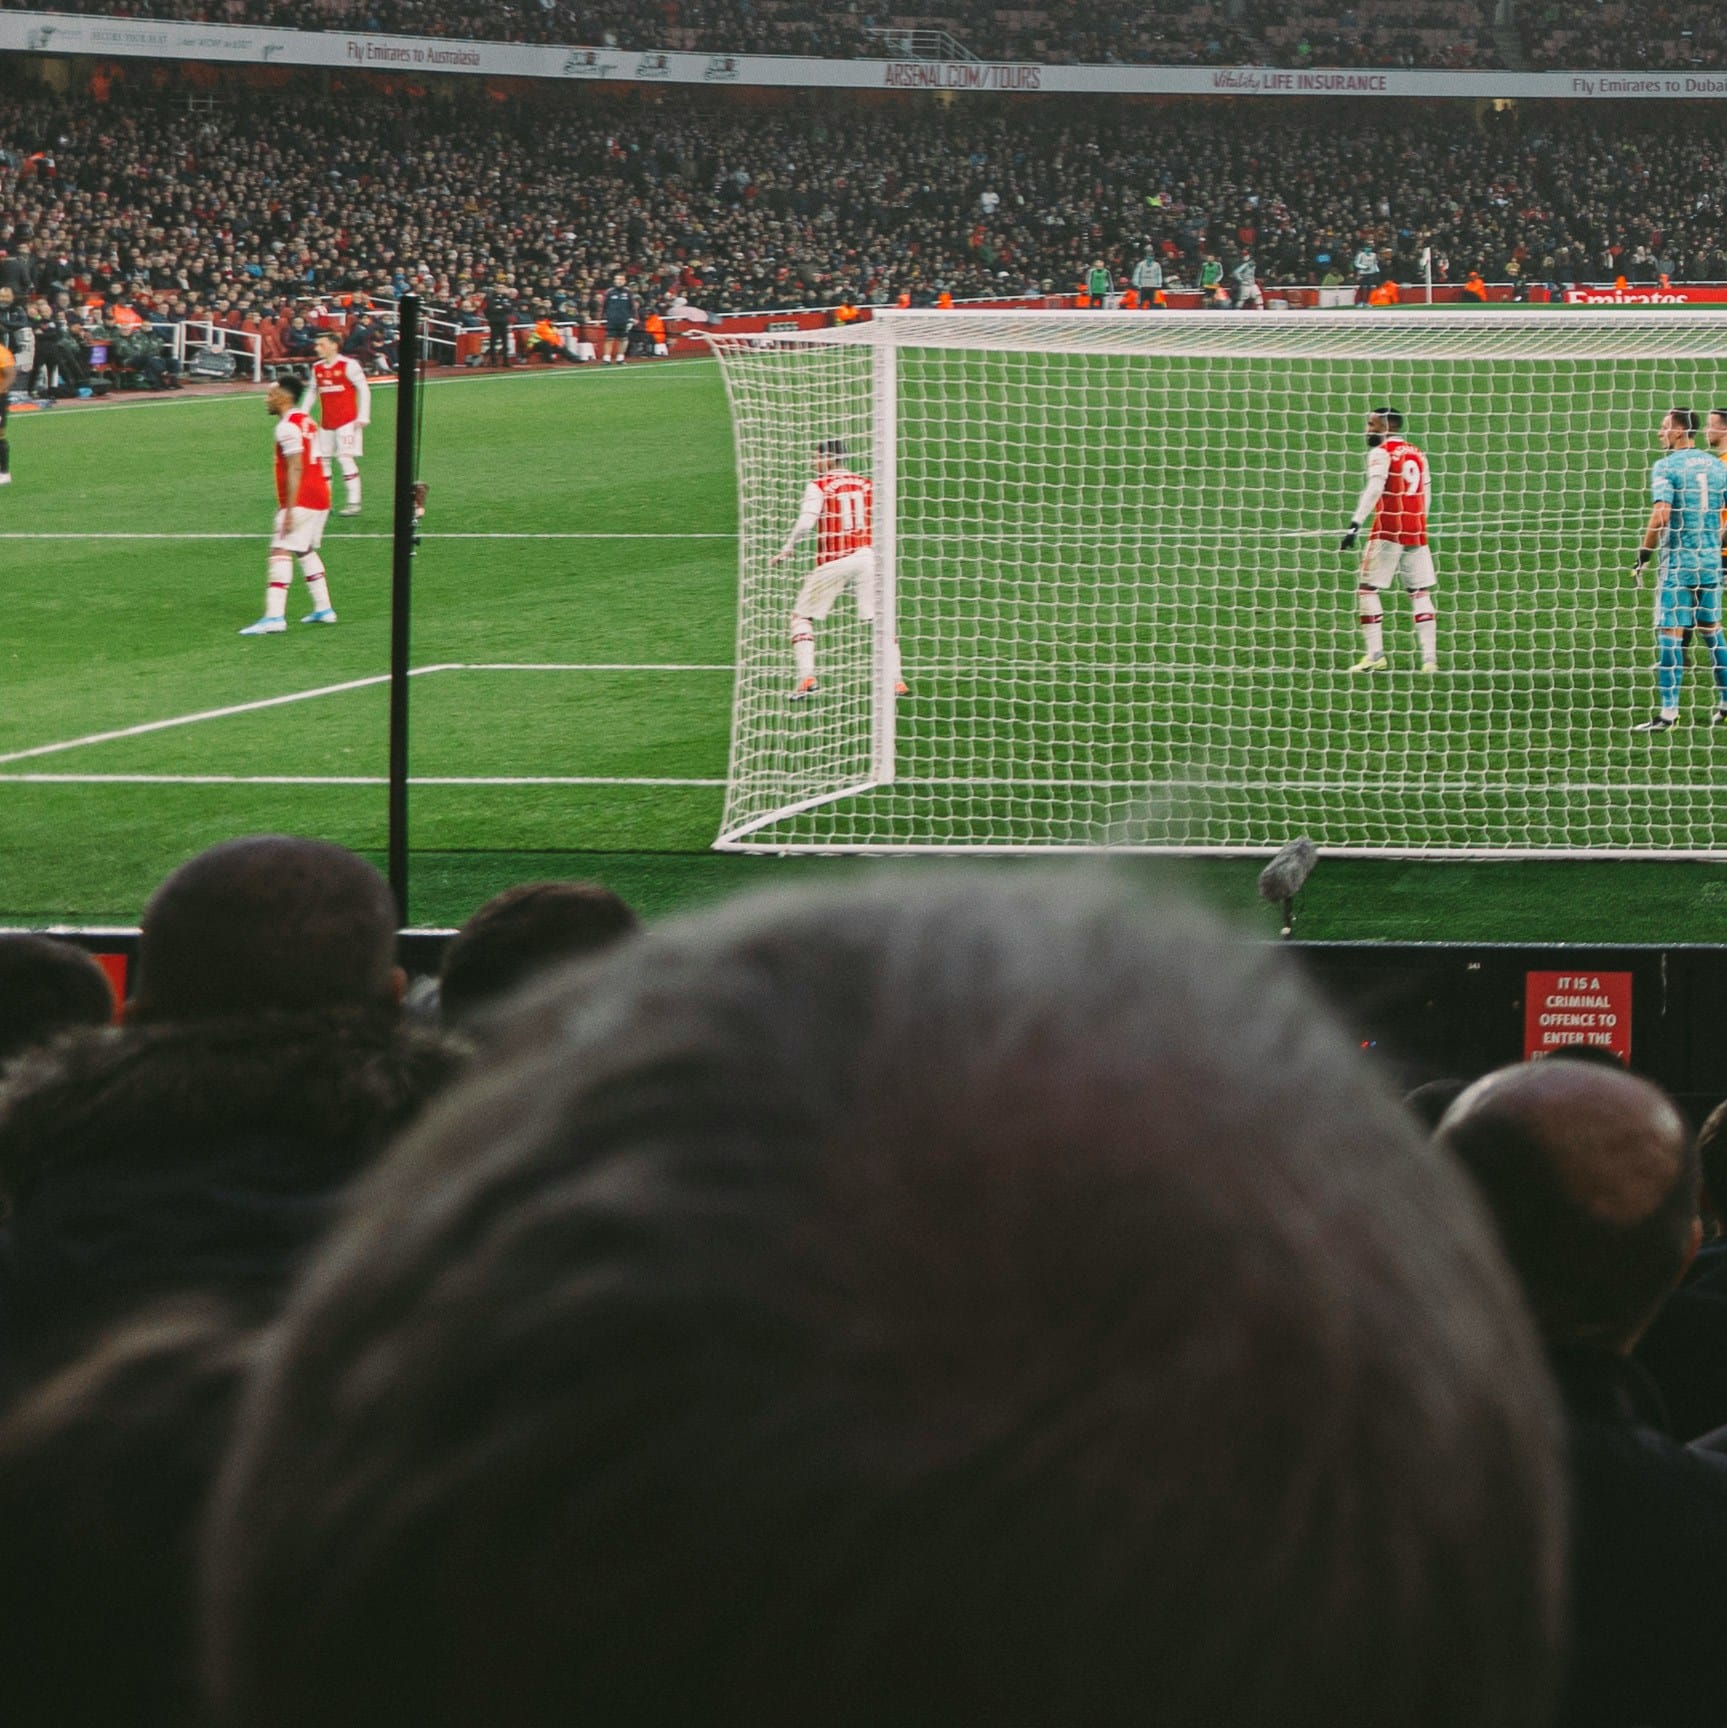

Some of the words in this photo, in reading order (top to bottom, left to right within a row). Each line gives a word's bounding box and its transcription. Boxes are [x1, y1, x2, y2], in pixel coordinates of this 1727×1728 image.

[347, 41, 365, 56] Fly
[366, 43, 412, 61] Emirates
[413, 48, 426, 62] to
[885, 65, 1041, 89] ARSENAL.COM/TOURS
[1213, 75, 1262, 92] Vitality
[1263, 75, 1293, 90] LIFE
[1297, 75, 1387, 91] INSURANCE
[1573, 79, 1594, 94] Fly
[1600, 78, 1660, 92] Emirates
[1665, 81, 1680, 93] to
[1402, 459, 1421, 496] 9
[1696, 472, 1709, 513] 1
[839, 492, 866, 531] 11
[1557, 977, 1572, 989] IT
[1574, 978, 1588, 989] IS
[1590, 978, 1601, 989] A
[1545, 995, 1611, 1008] CRIMINAL
[1539, 1014, 1596, 1027] OFFENCE
[1597, 1014, 1617, 1027] TO
[1542, 1032, 1585, 1044] ENTER
[1587, 1032, 1613, 1045] THE
